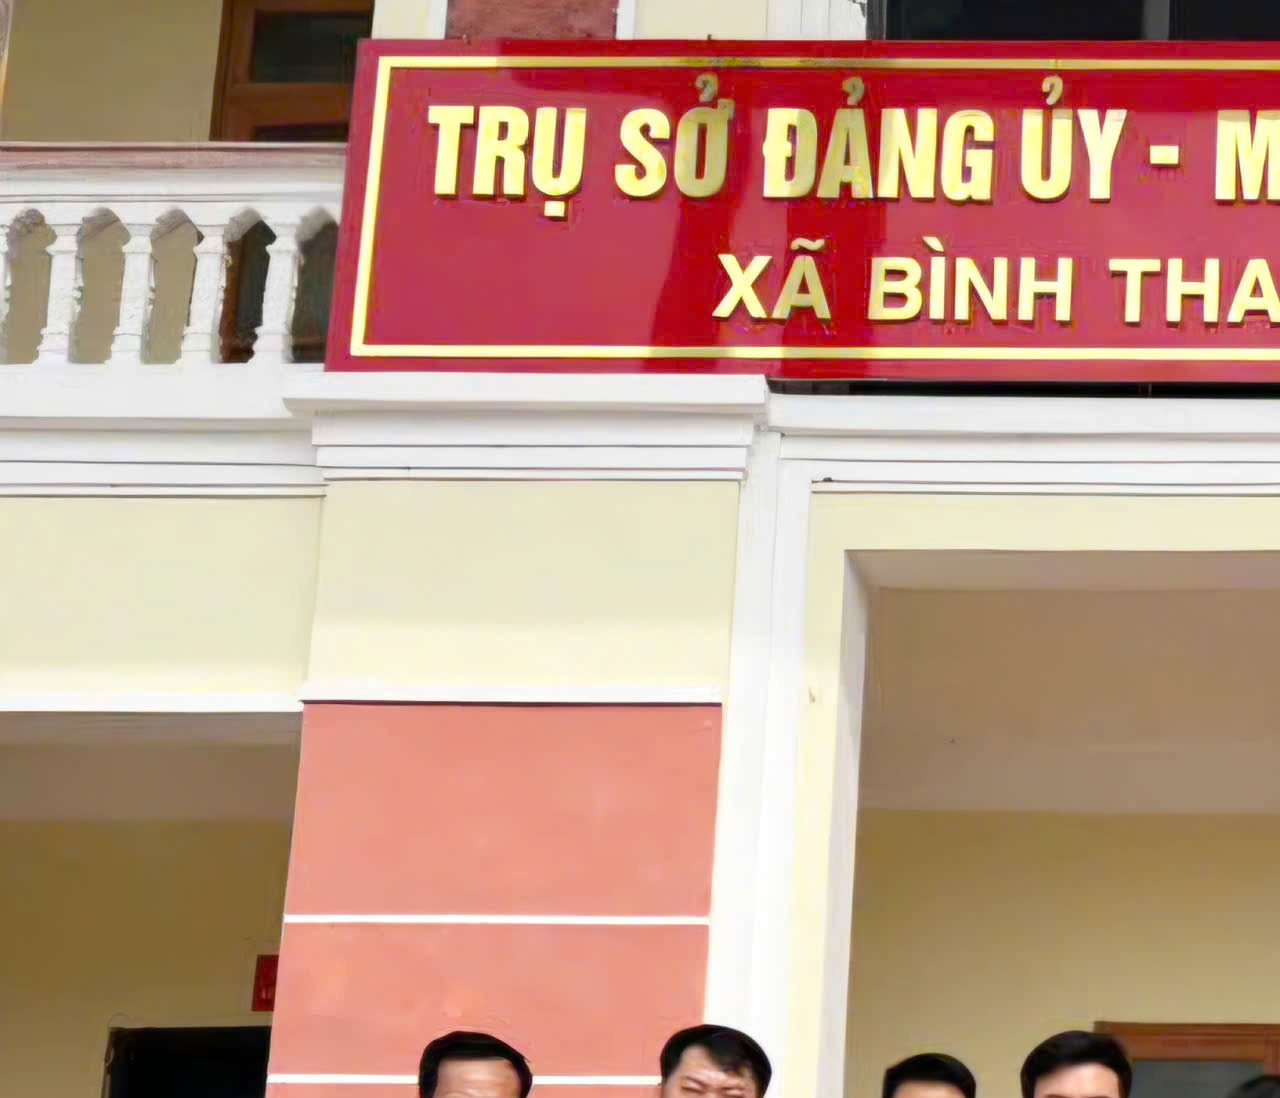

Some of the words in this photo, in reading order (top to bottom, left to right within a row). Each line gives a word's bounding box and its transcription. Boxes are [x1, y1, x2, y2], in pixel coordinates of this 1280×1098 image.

[428, 105, 587, 218] TRỤ
[615, 73, 735, 199] SỞ
[763, 75, 995, 202] ĐẢNG
[1021, 74, 1127, 202] ỦY
[1150, 145, 1179, 166] -
[711, 237, 831, 321] XÃ
[868, 235, 1074, 323] BÌNH
